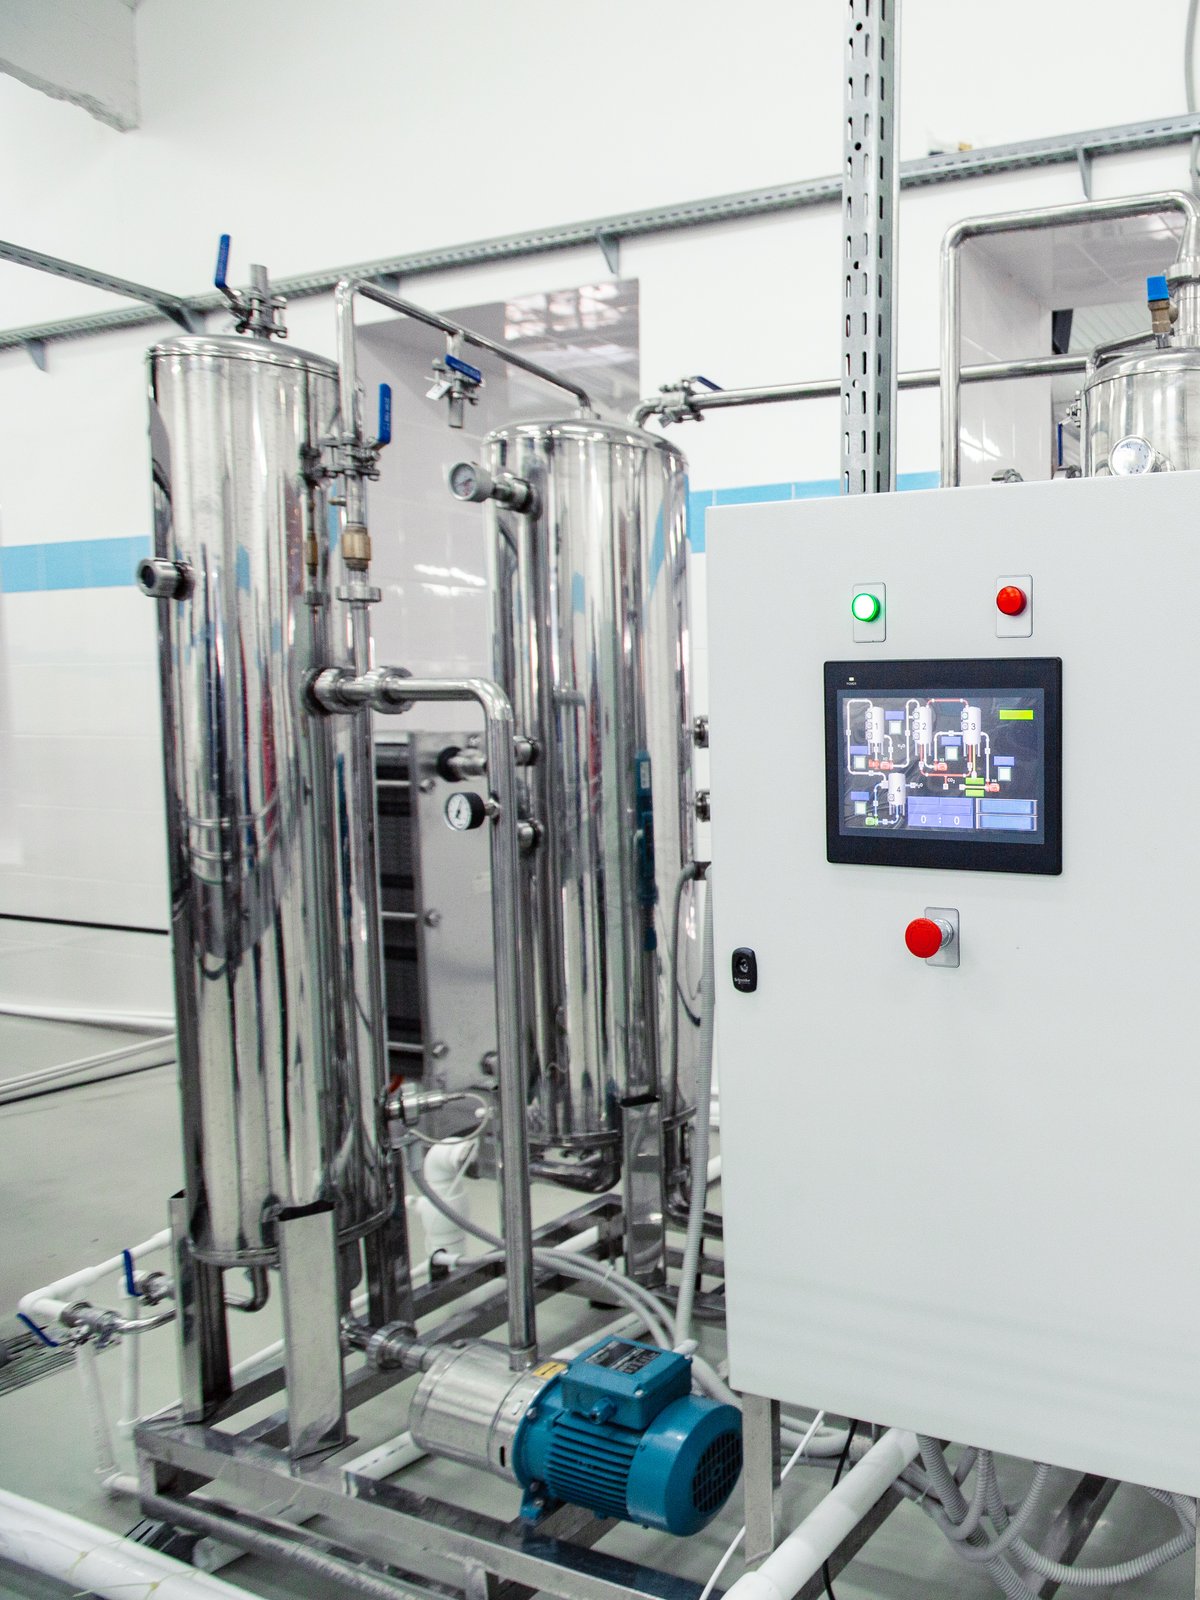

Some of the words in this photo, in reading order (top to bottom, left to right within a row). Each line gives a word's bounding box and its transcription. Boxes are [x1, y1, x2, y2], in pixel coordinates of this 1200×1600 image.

[921, 722, 927, 731] 2
[970, 722, 976, 731] 3
[920, 815, 927, 824] 0
[953, 816, 960, 825] 0
